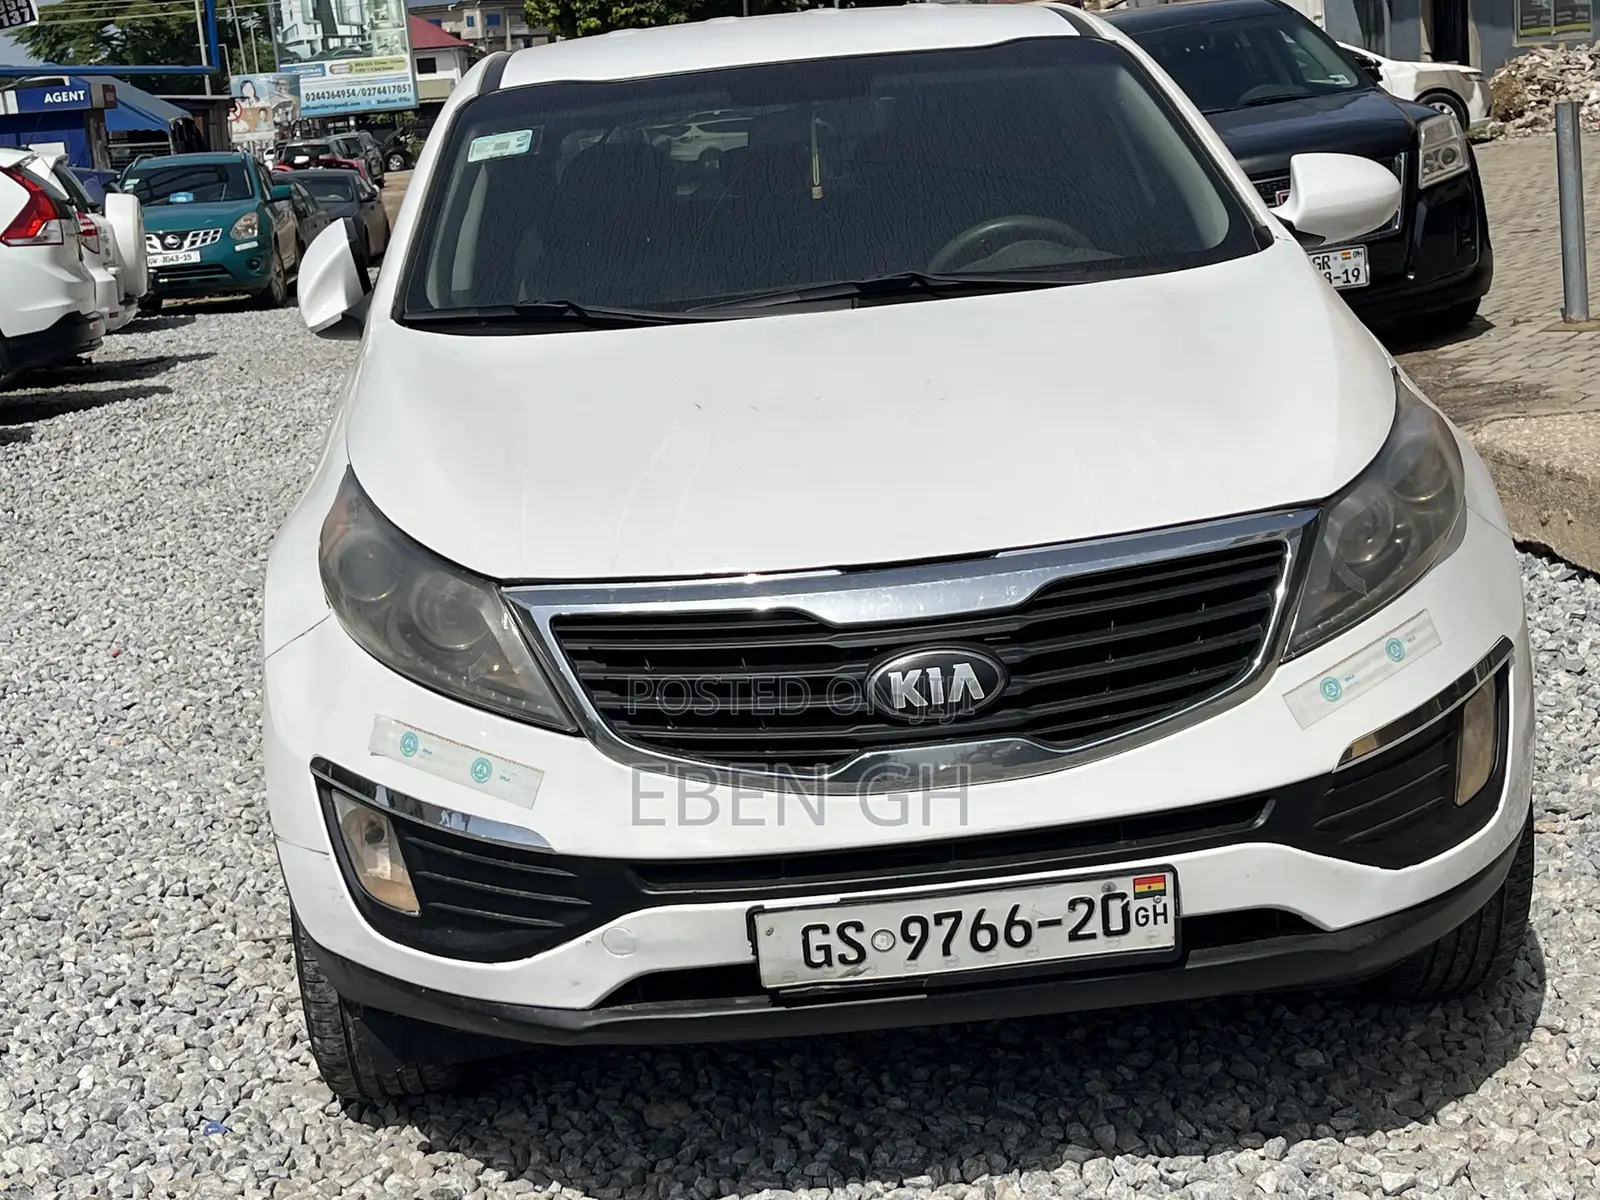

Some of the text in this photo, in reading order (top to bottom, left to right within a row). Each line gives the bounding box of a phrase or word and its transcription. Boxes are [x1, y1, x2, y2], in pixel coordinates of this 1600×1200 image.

[44, 90, 85, 103] AGENT
[1312, 255, 1331, 270] GR
[889, 662, 984, 709] KIA
[801, 891, 1168, 968] GS 9766-20 GH
